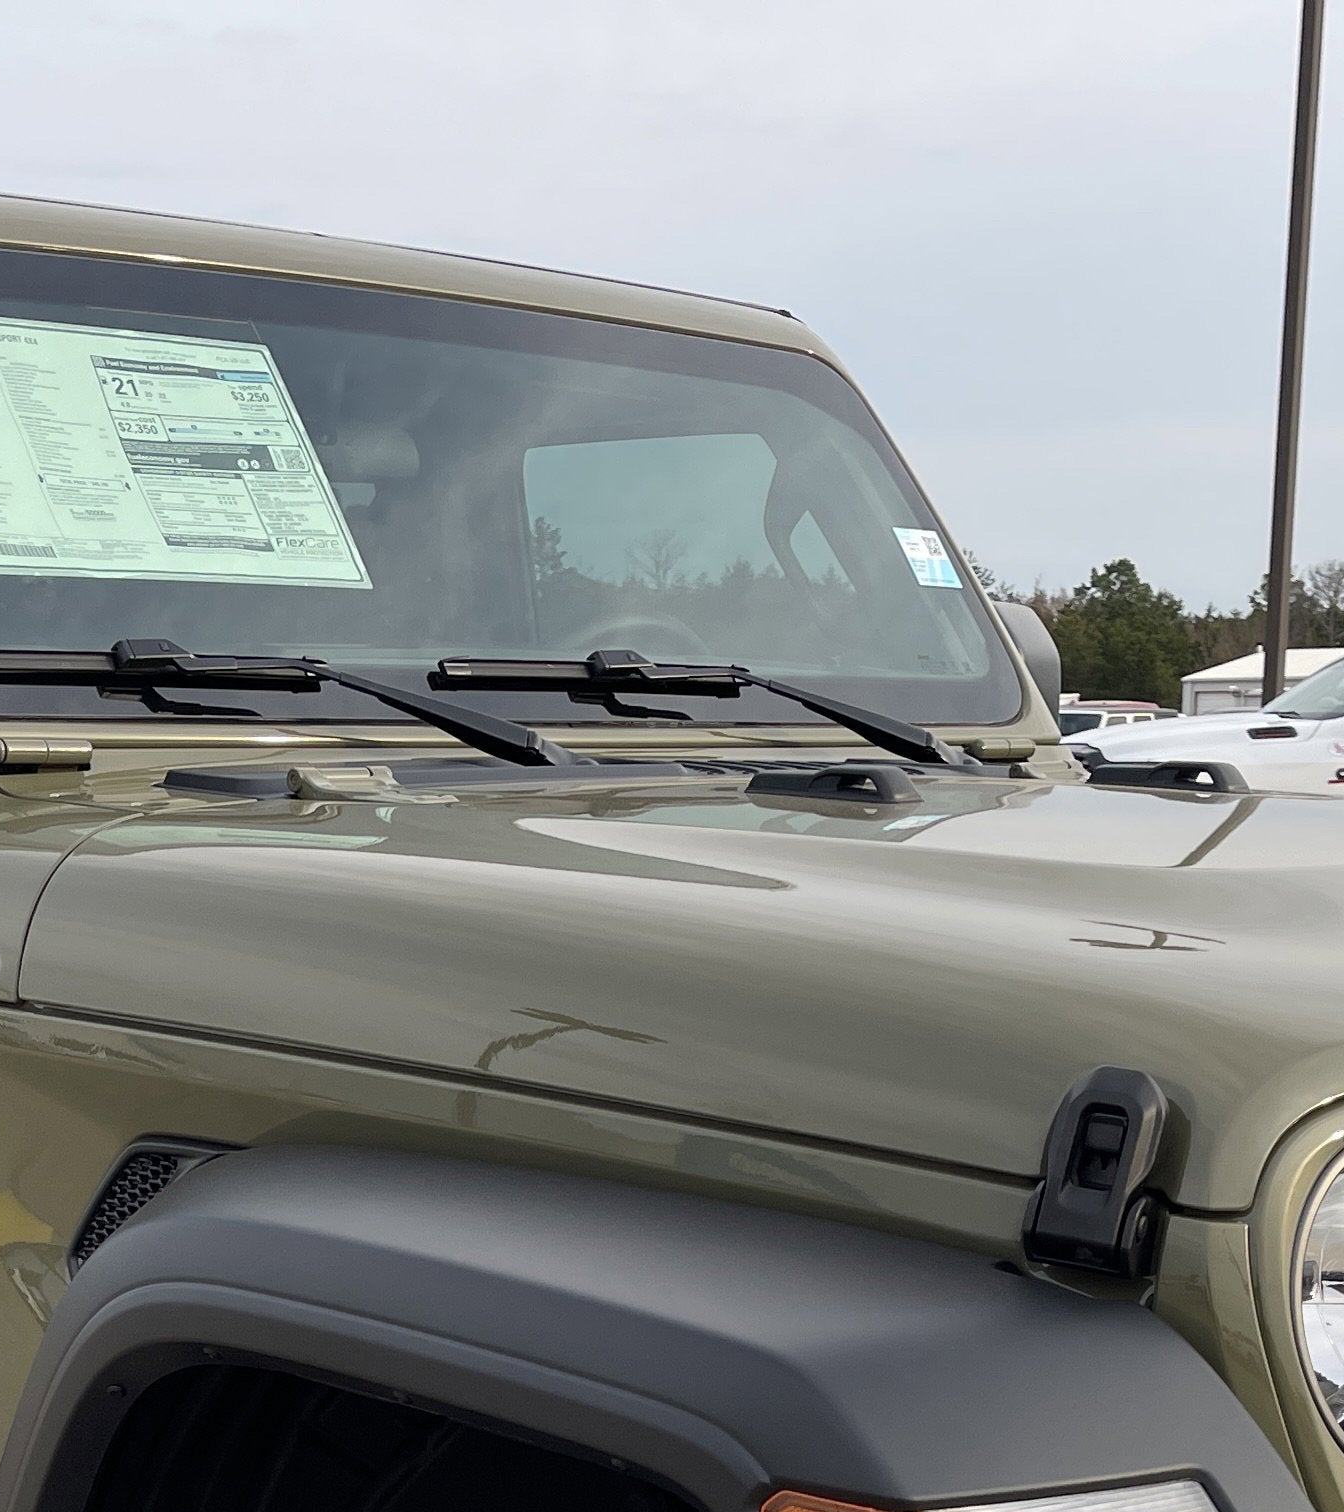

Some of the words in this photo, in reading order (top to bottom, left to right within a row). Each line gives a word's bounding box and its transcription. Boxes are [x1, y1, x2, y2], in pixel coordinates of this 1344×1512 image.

[111, 377, 139, 397] 21
[230, 390, 270, 403] $3,250
[118, 422, 159, 435] $2,350
[275, 536, 340, 550] FlexCare
